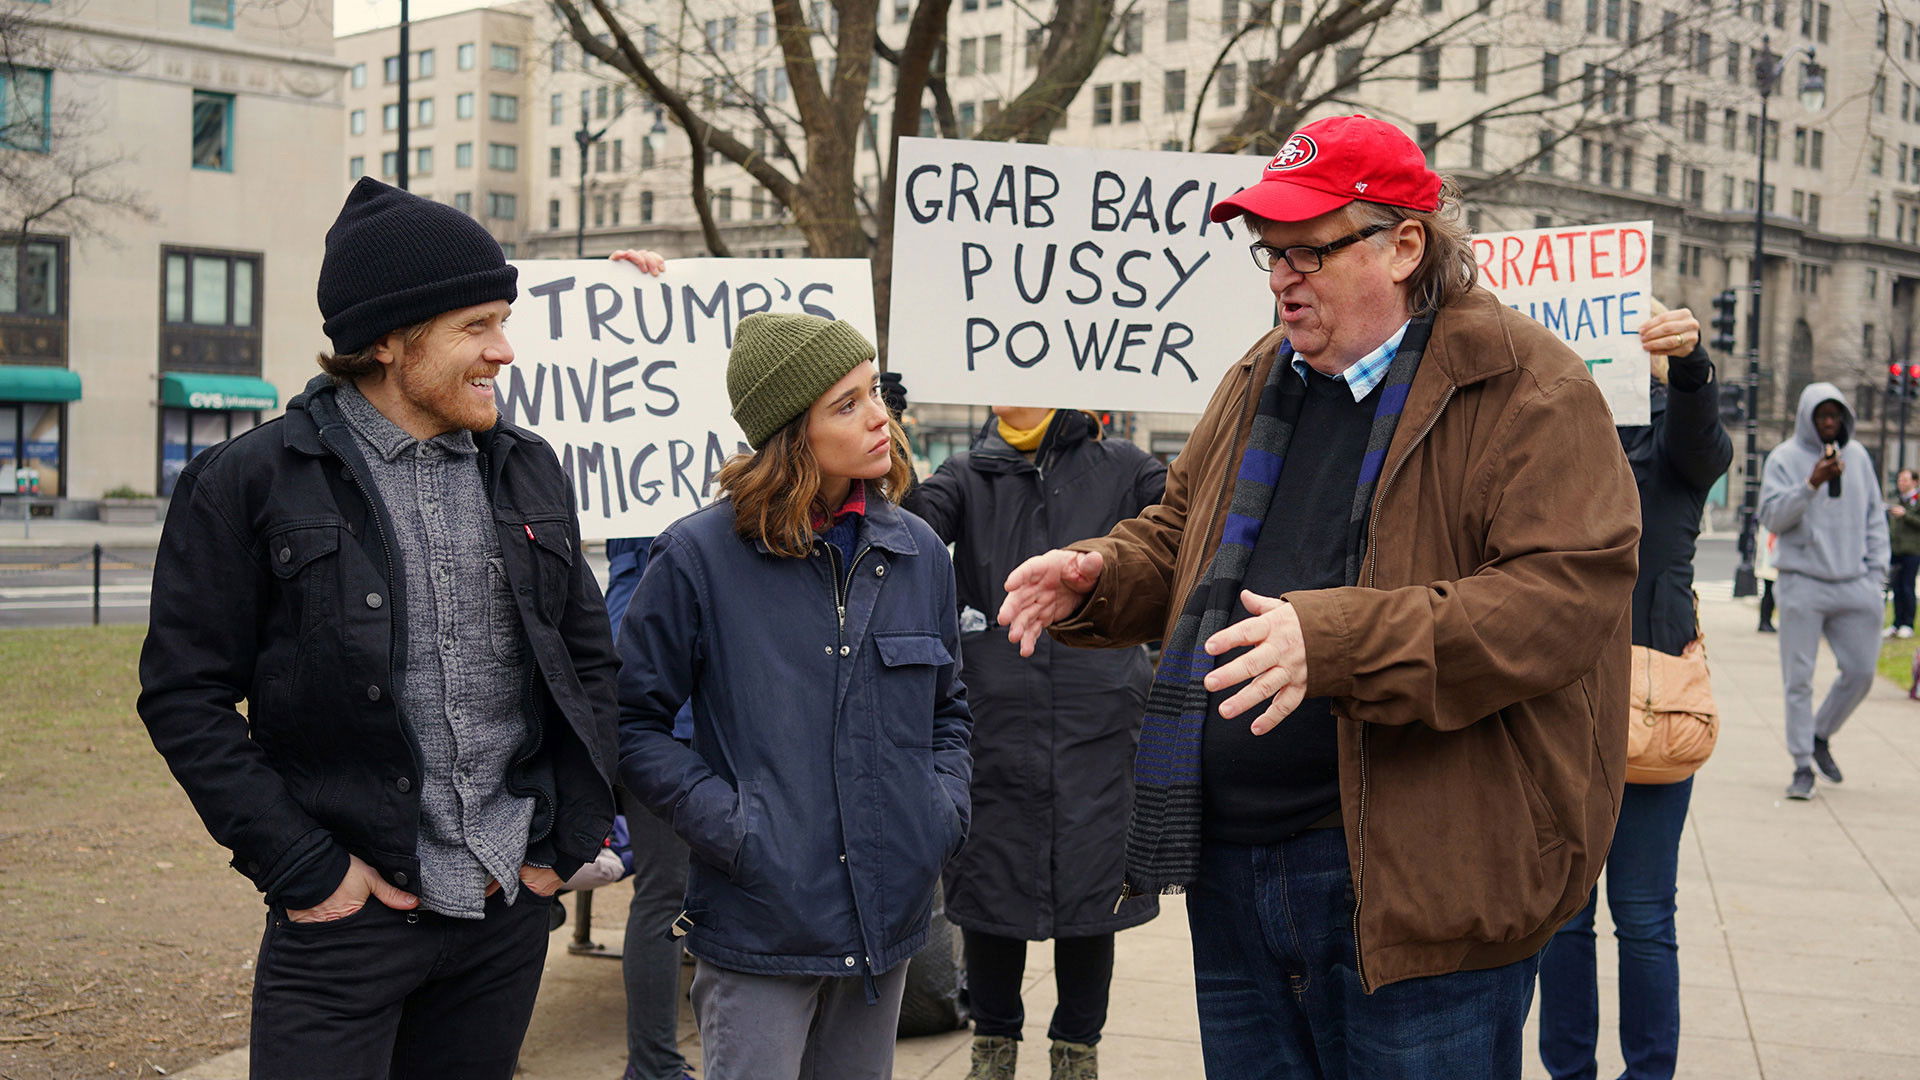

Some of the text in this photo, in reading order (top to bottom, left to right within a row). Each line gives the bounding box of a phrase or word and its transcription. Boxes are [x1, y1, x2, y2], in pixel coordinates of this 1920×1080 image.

[906, 162, 1246, 240] GRAB BACK
[962, 240, 1211, 312] PUSSY
[528, 276, 836, 349] TRUMP'S
[966, 317, 1199, 383] POWER
[493, 356, 680, 426] WIVES
